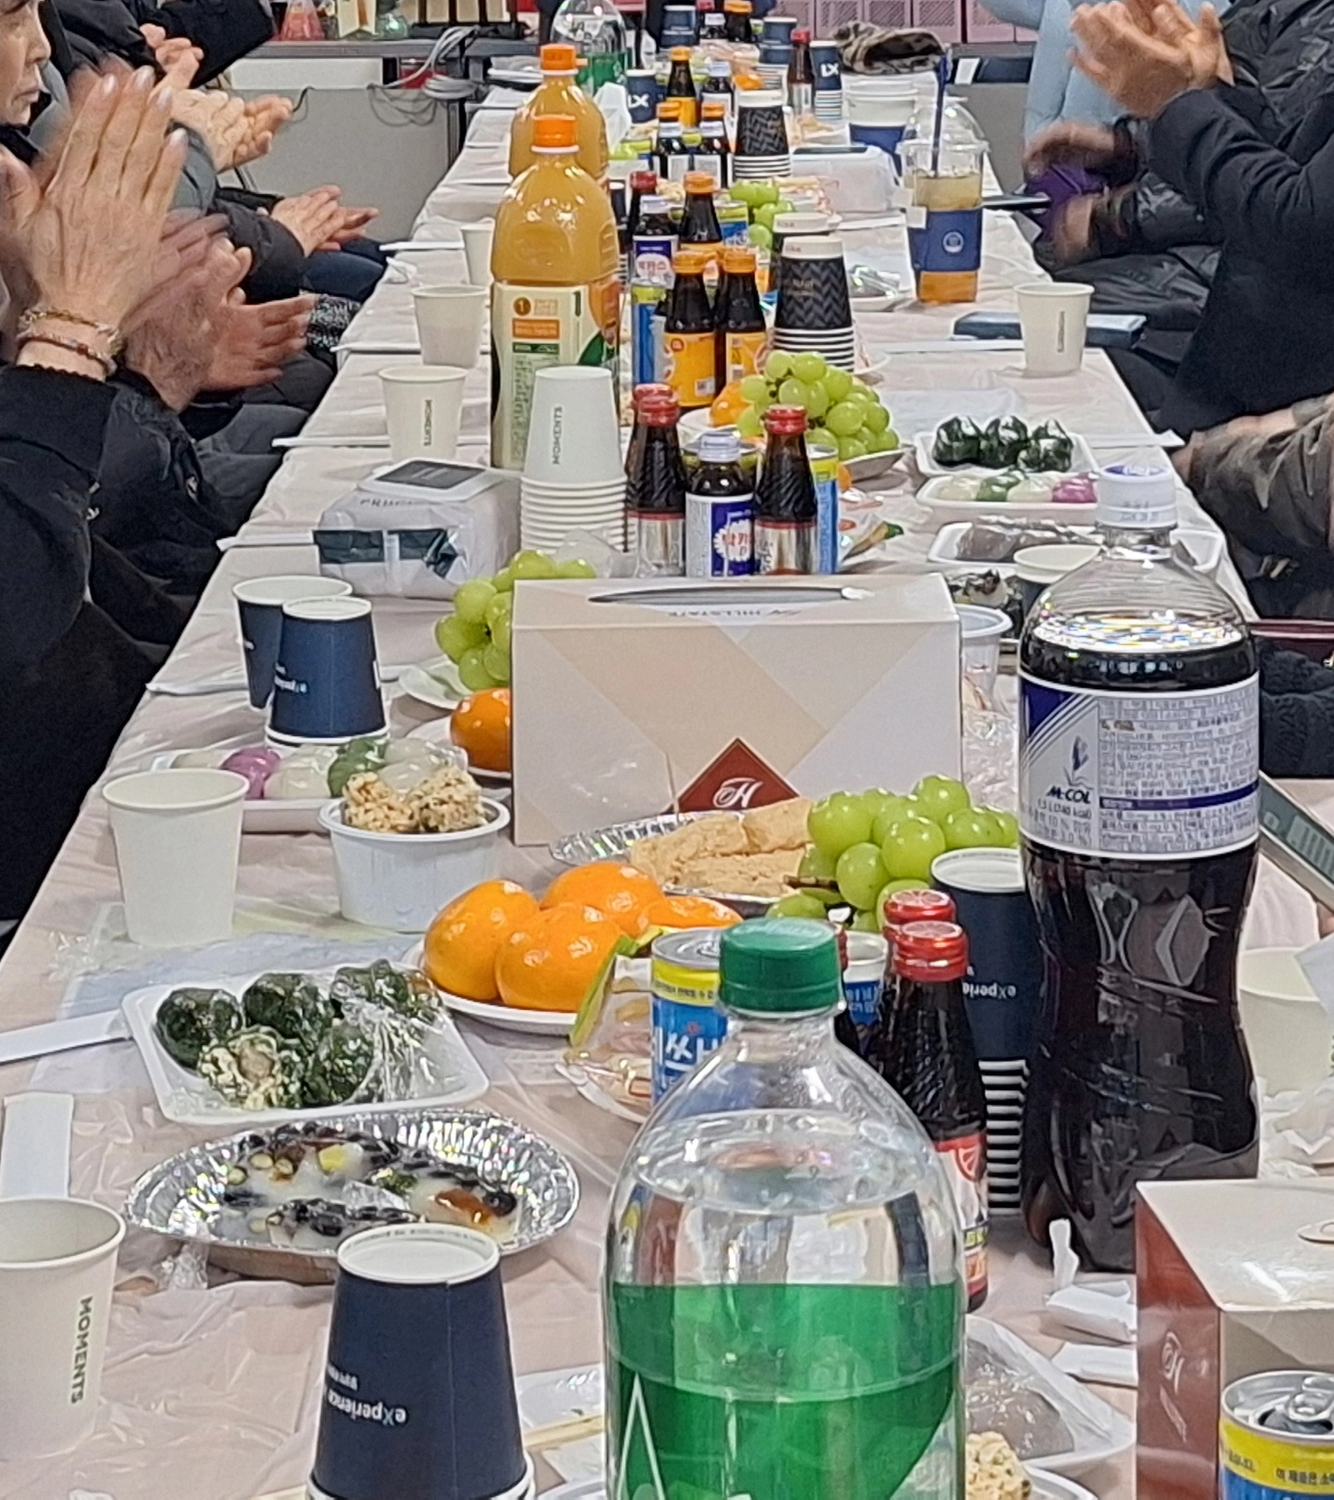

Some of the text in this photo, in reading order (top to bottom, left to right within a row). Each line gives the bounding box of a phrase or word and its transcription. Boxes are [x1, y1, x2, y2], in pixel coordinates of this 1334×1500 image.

[821, 63, 839, 77] LX
[627, 94, 649, 109] LX
[552, 406, 563, 465] MOMENTS
[71, 1296, 93, 1404] MOMENTS
